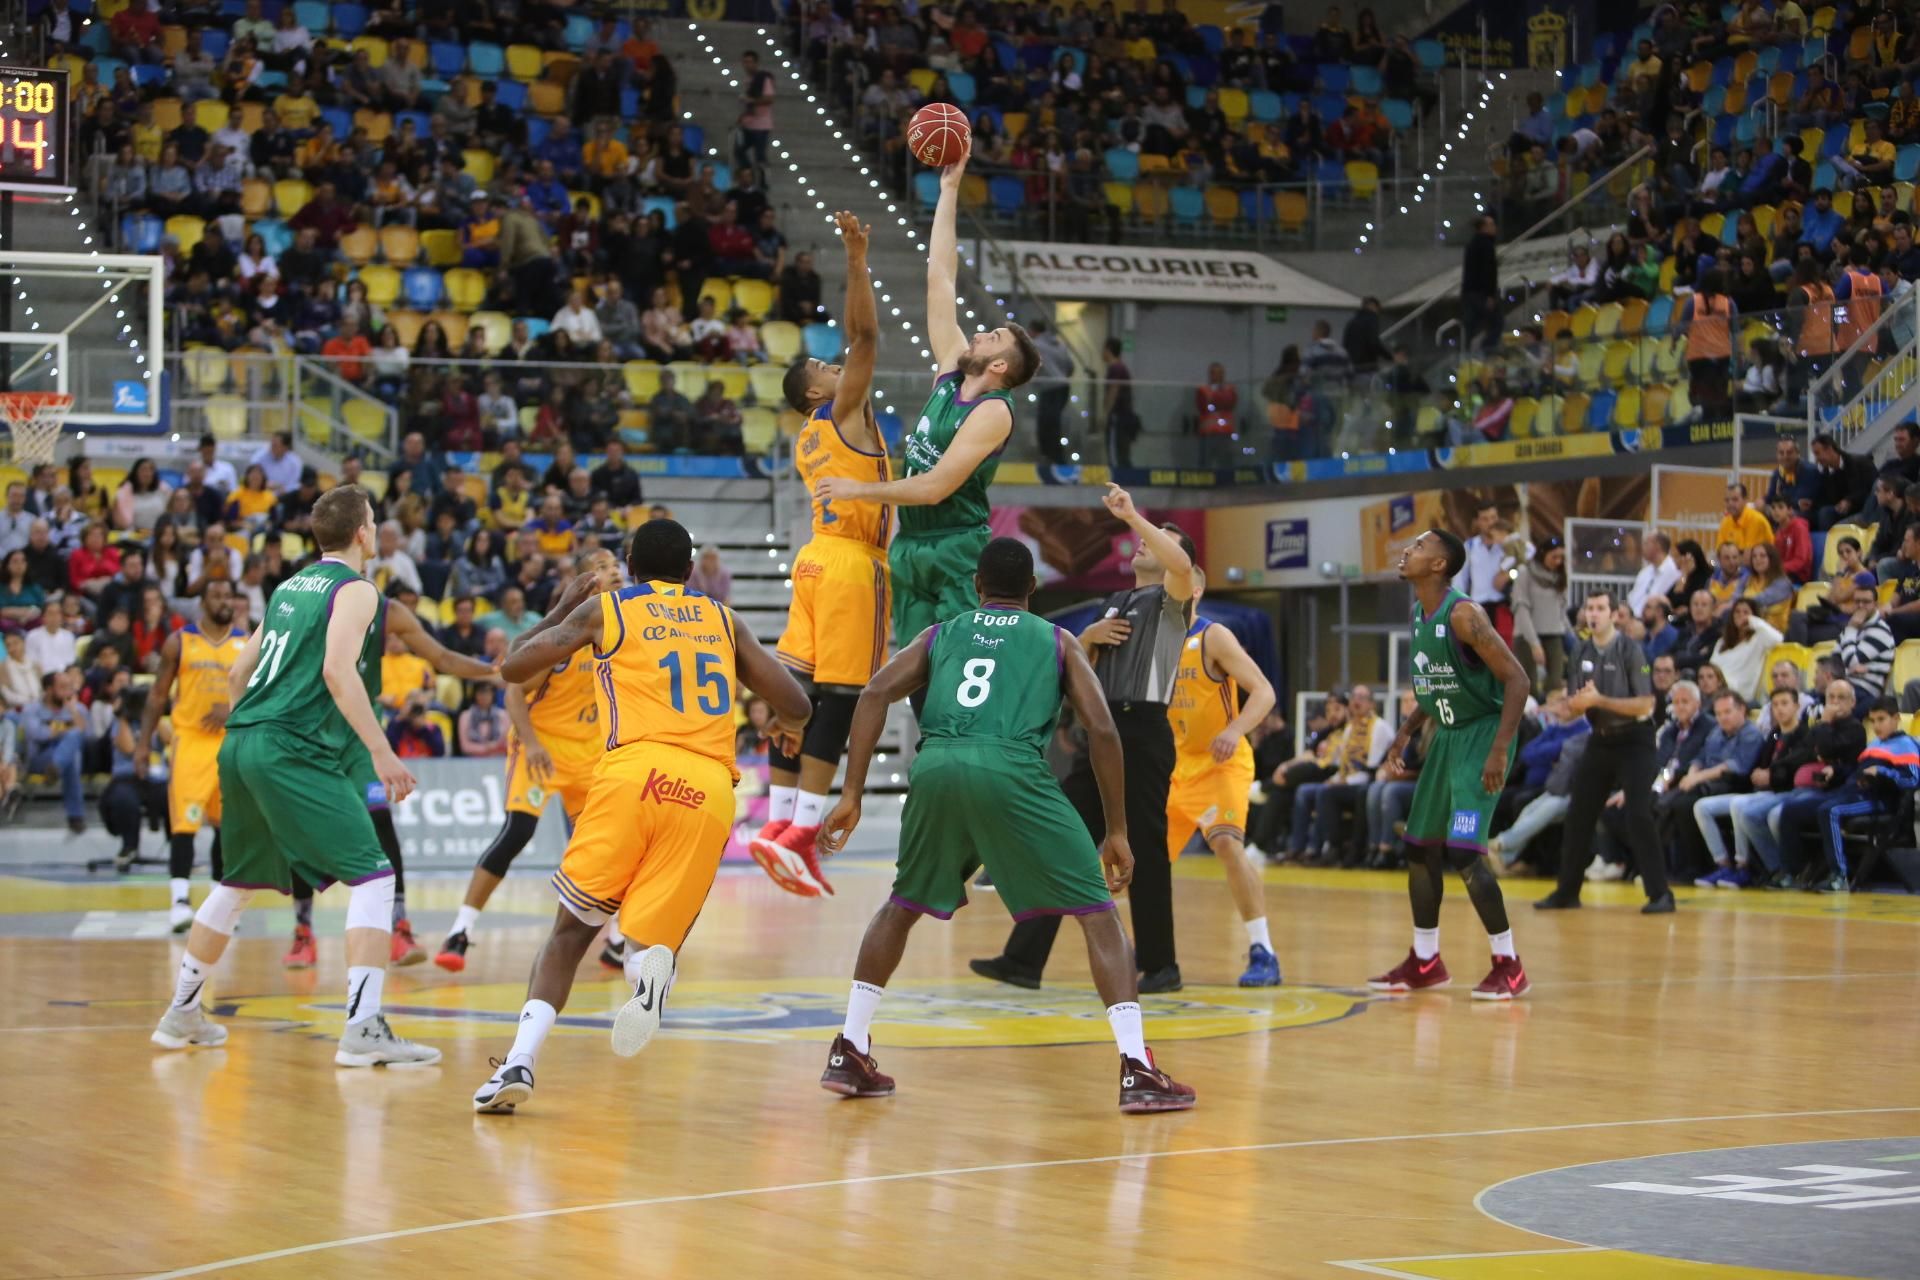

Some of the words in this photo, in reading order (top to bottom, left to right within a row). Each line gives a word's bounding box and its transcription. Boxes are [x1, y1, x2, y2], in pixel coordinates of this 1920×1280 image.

[0, 116, 44, 171] 4
[973, 612, 1020, 626] FOGG
[246, 629, 291, 688] 21
[658, 650, 731, 716] 15
[956, 658, 996, 708] 8
[1435, 698, 1455, 725] 15
[393, 775, 507, 828] rcel
[640, 767, 706, 810] Kalise
